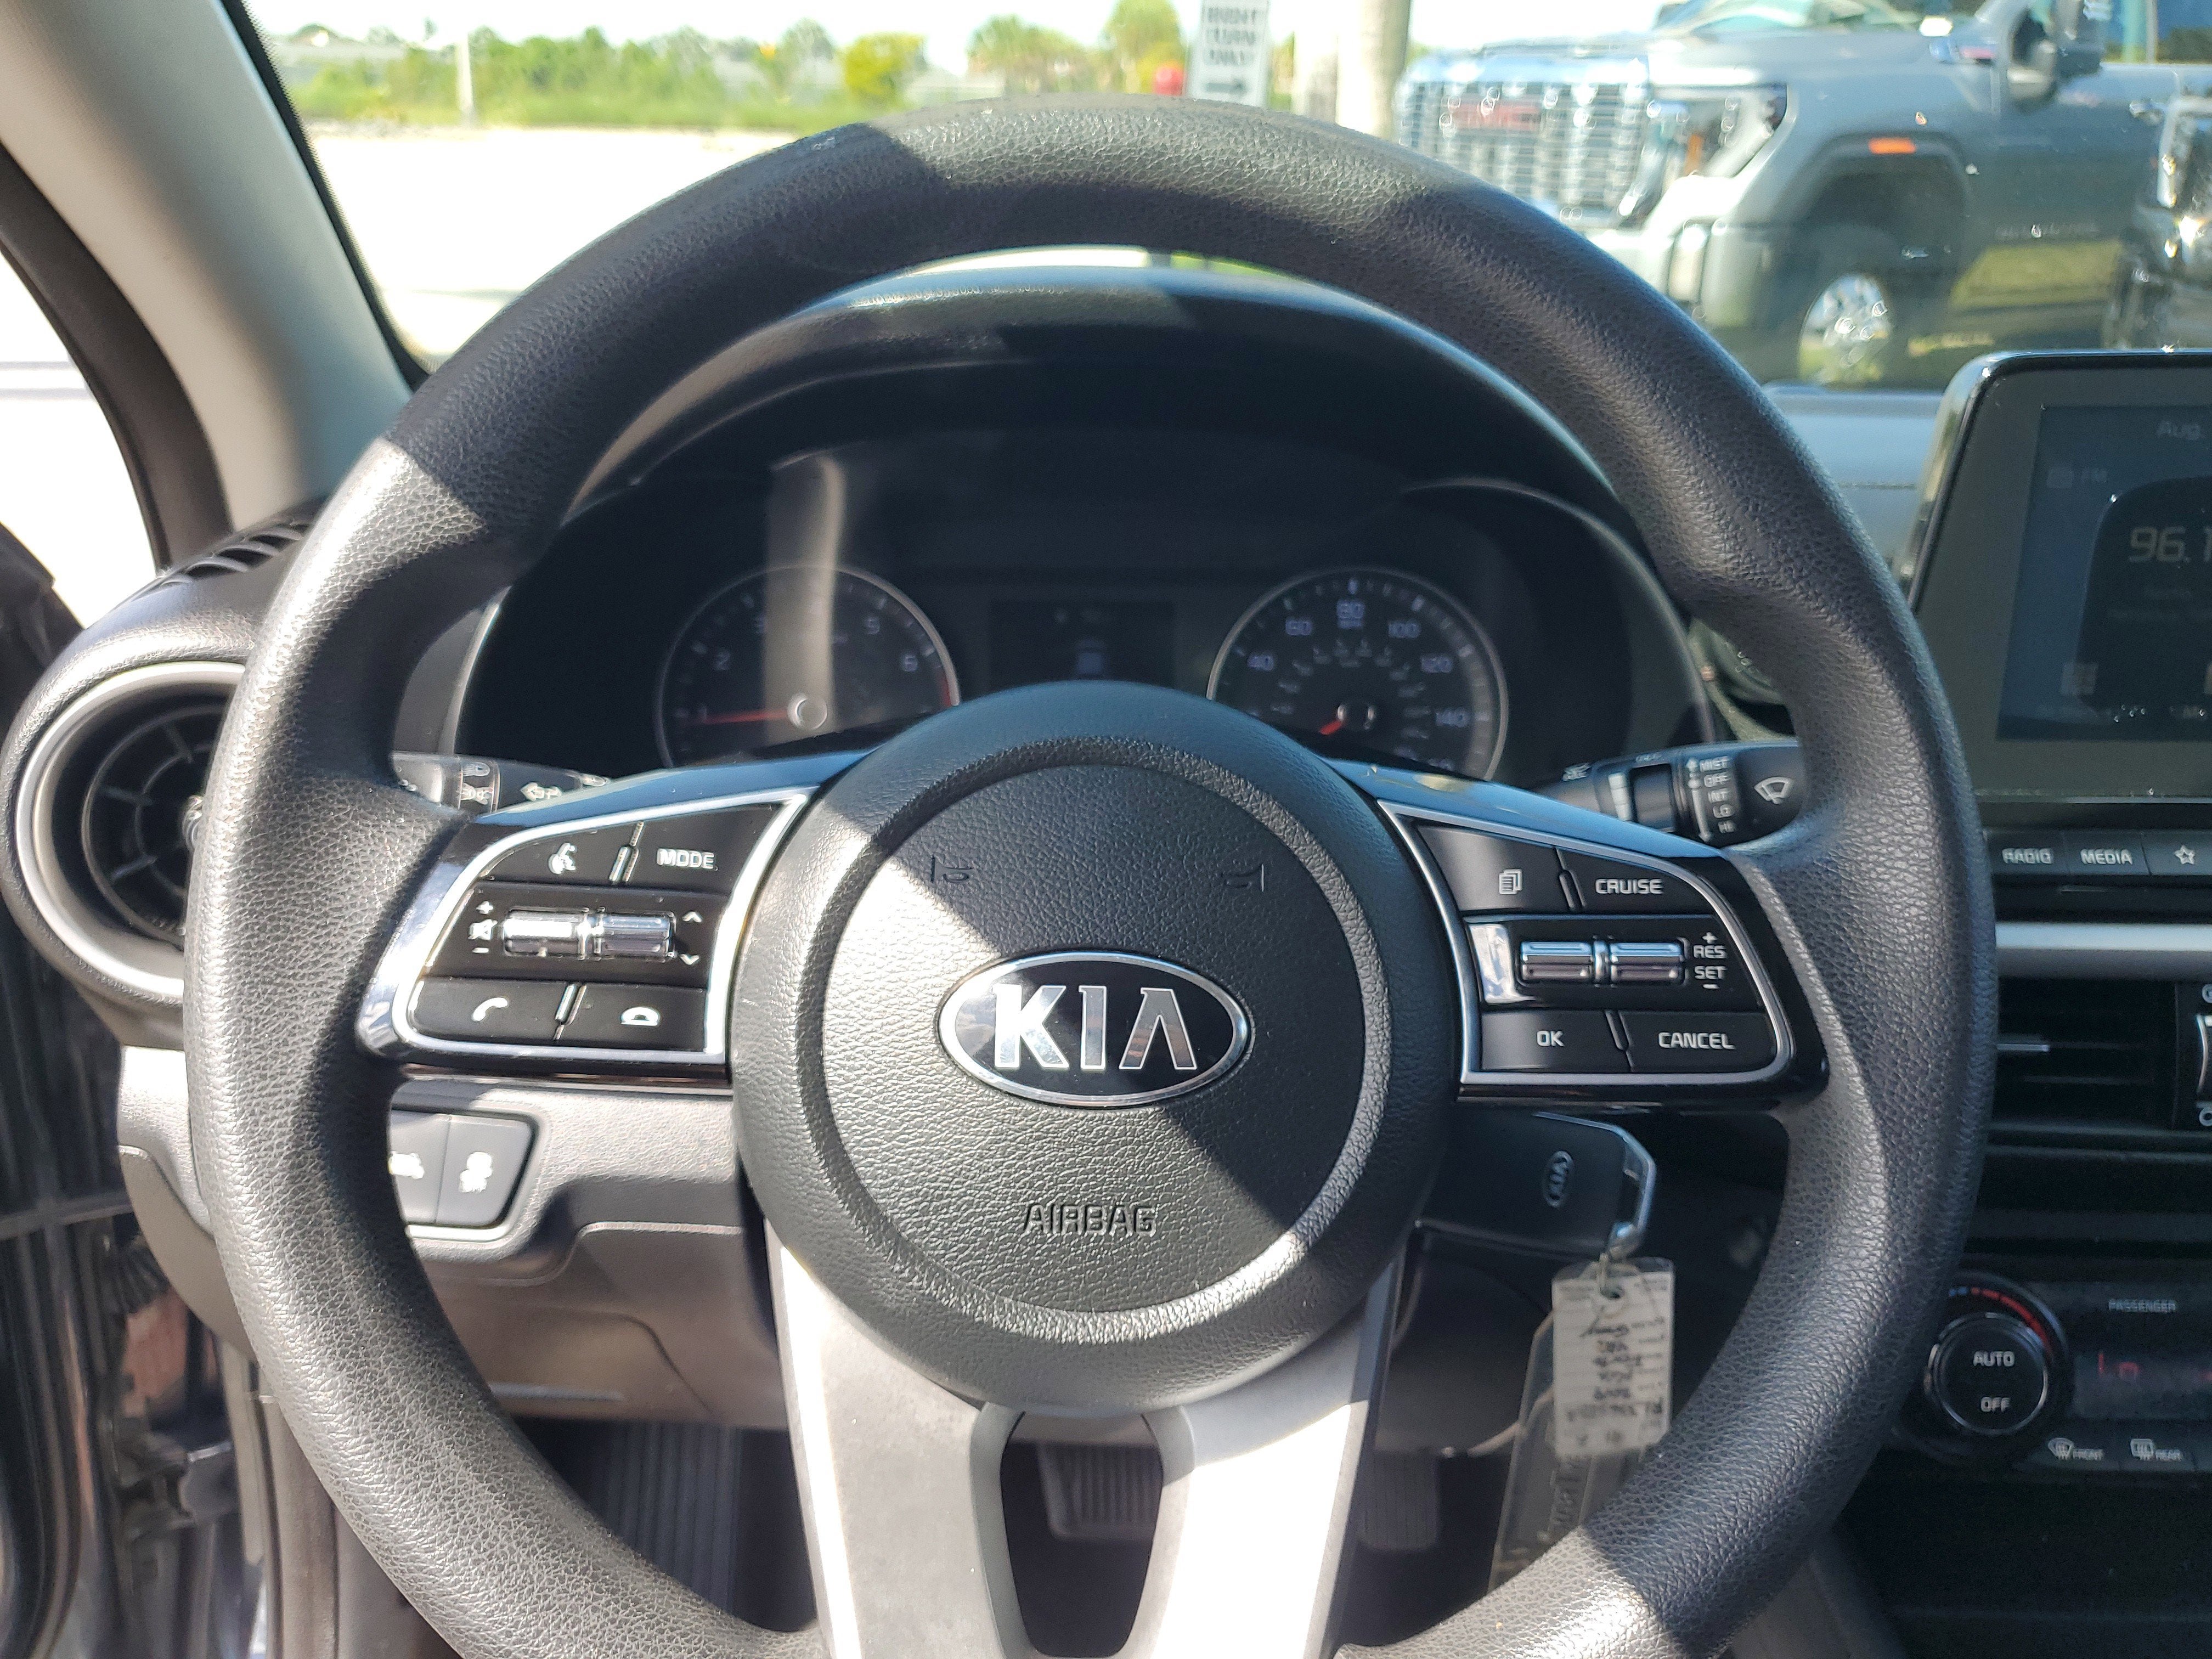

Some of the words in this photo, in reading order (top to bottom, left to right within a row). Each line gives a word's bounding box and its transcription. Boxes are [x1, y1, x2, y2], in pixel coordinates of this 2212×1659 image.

[657, 848, 715, 870] MODE
[2002, 848, 2054, 865] RADIO
[2080, 848, 2133, 865] MEDIA
[1595, 878, 1663, 895] CRUISE
[1694, 945, 1726, 960] RES
[1695, 966, 1726, 980] SET
[991, 984, 1198, 1070] KIA
[1537, 1030, 1564, 1047] OK
[1658, 1031, 1735, 1050] CANCEL
[1023, 1203, 1158, 1238] AIRBAG
[2108, 1299, 2176, 1313] PASSENGER
[1973, 1350, 2016, 1367] AUTO
[1980, 1397, 2011, 1413] OFF
